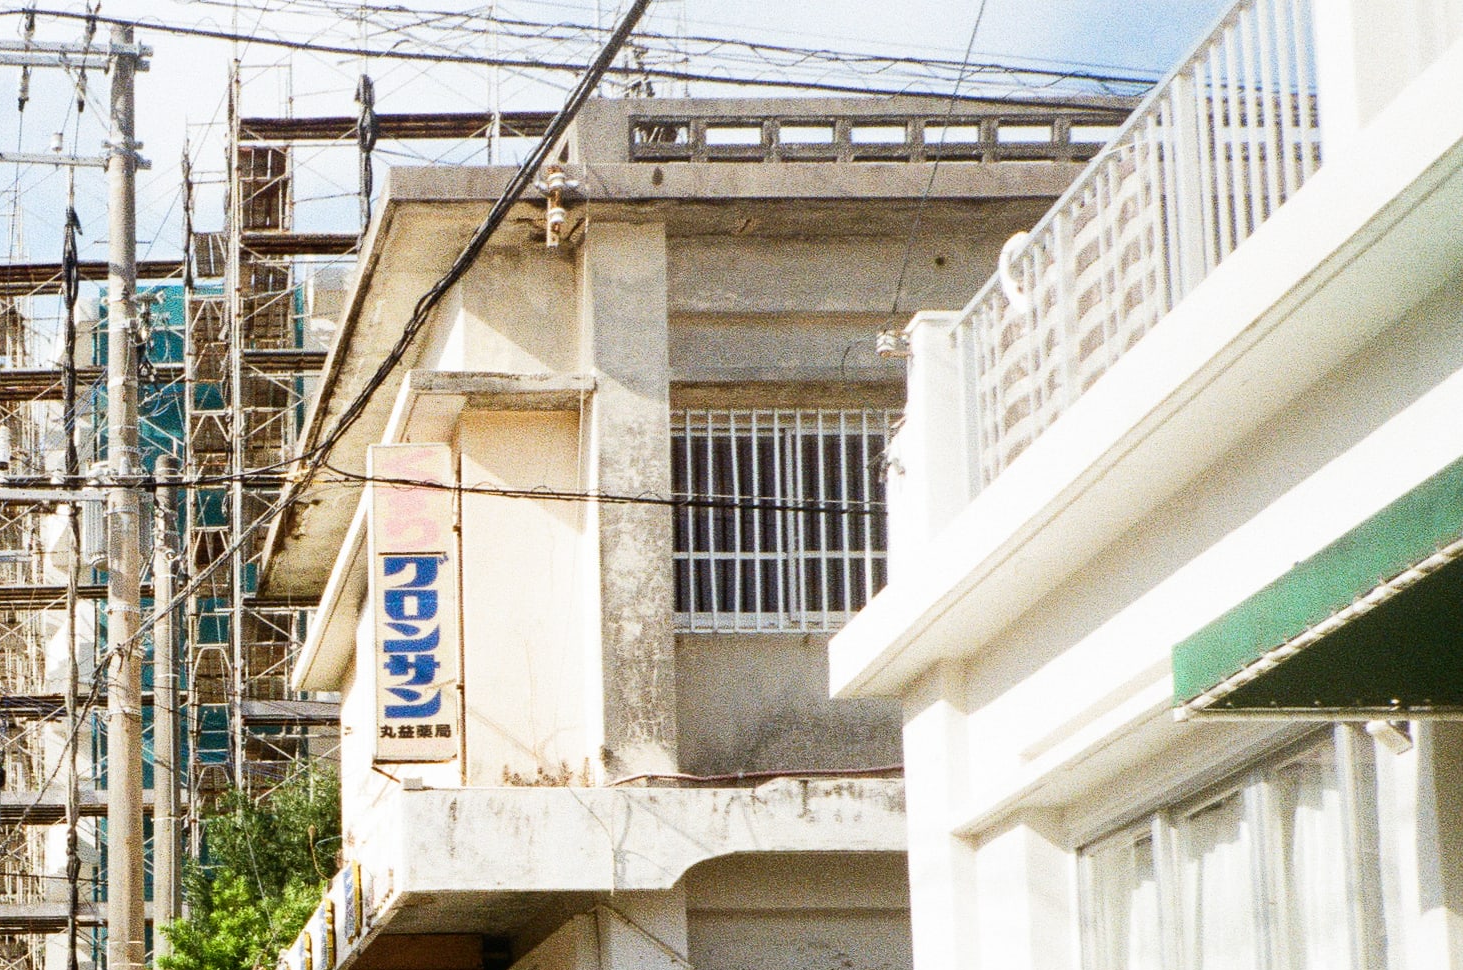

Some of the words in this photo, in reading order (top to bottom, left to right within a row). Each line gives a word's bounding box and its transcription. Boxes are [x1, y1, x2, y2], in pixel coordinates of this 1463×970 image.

[383, 555, 448, 719] グロンサン
[380, 723, 452, 739] 丸益薬局
